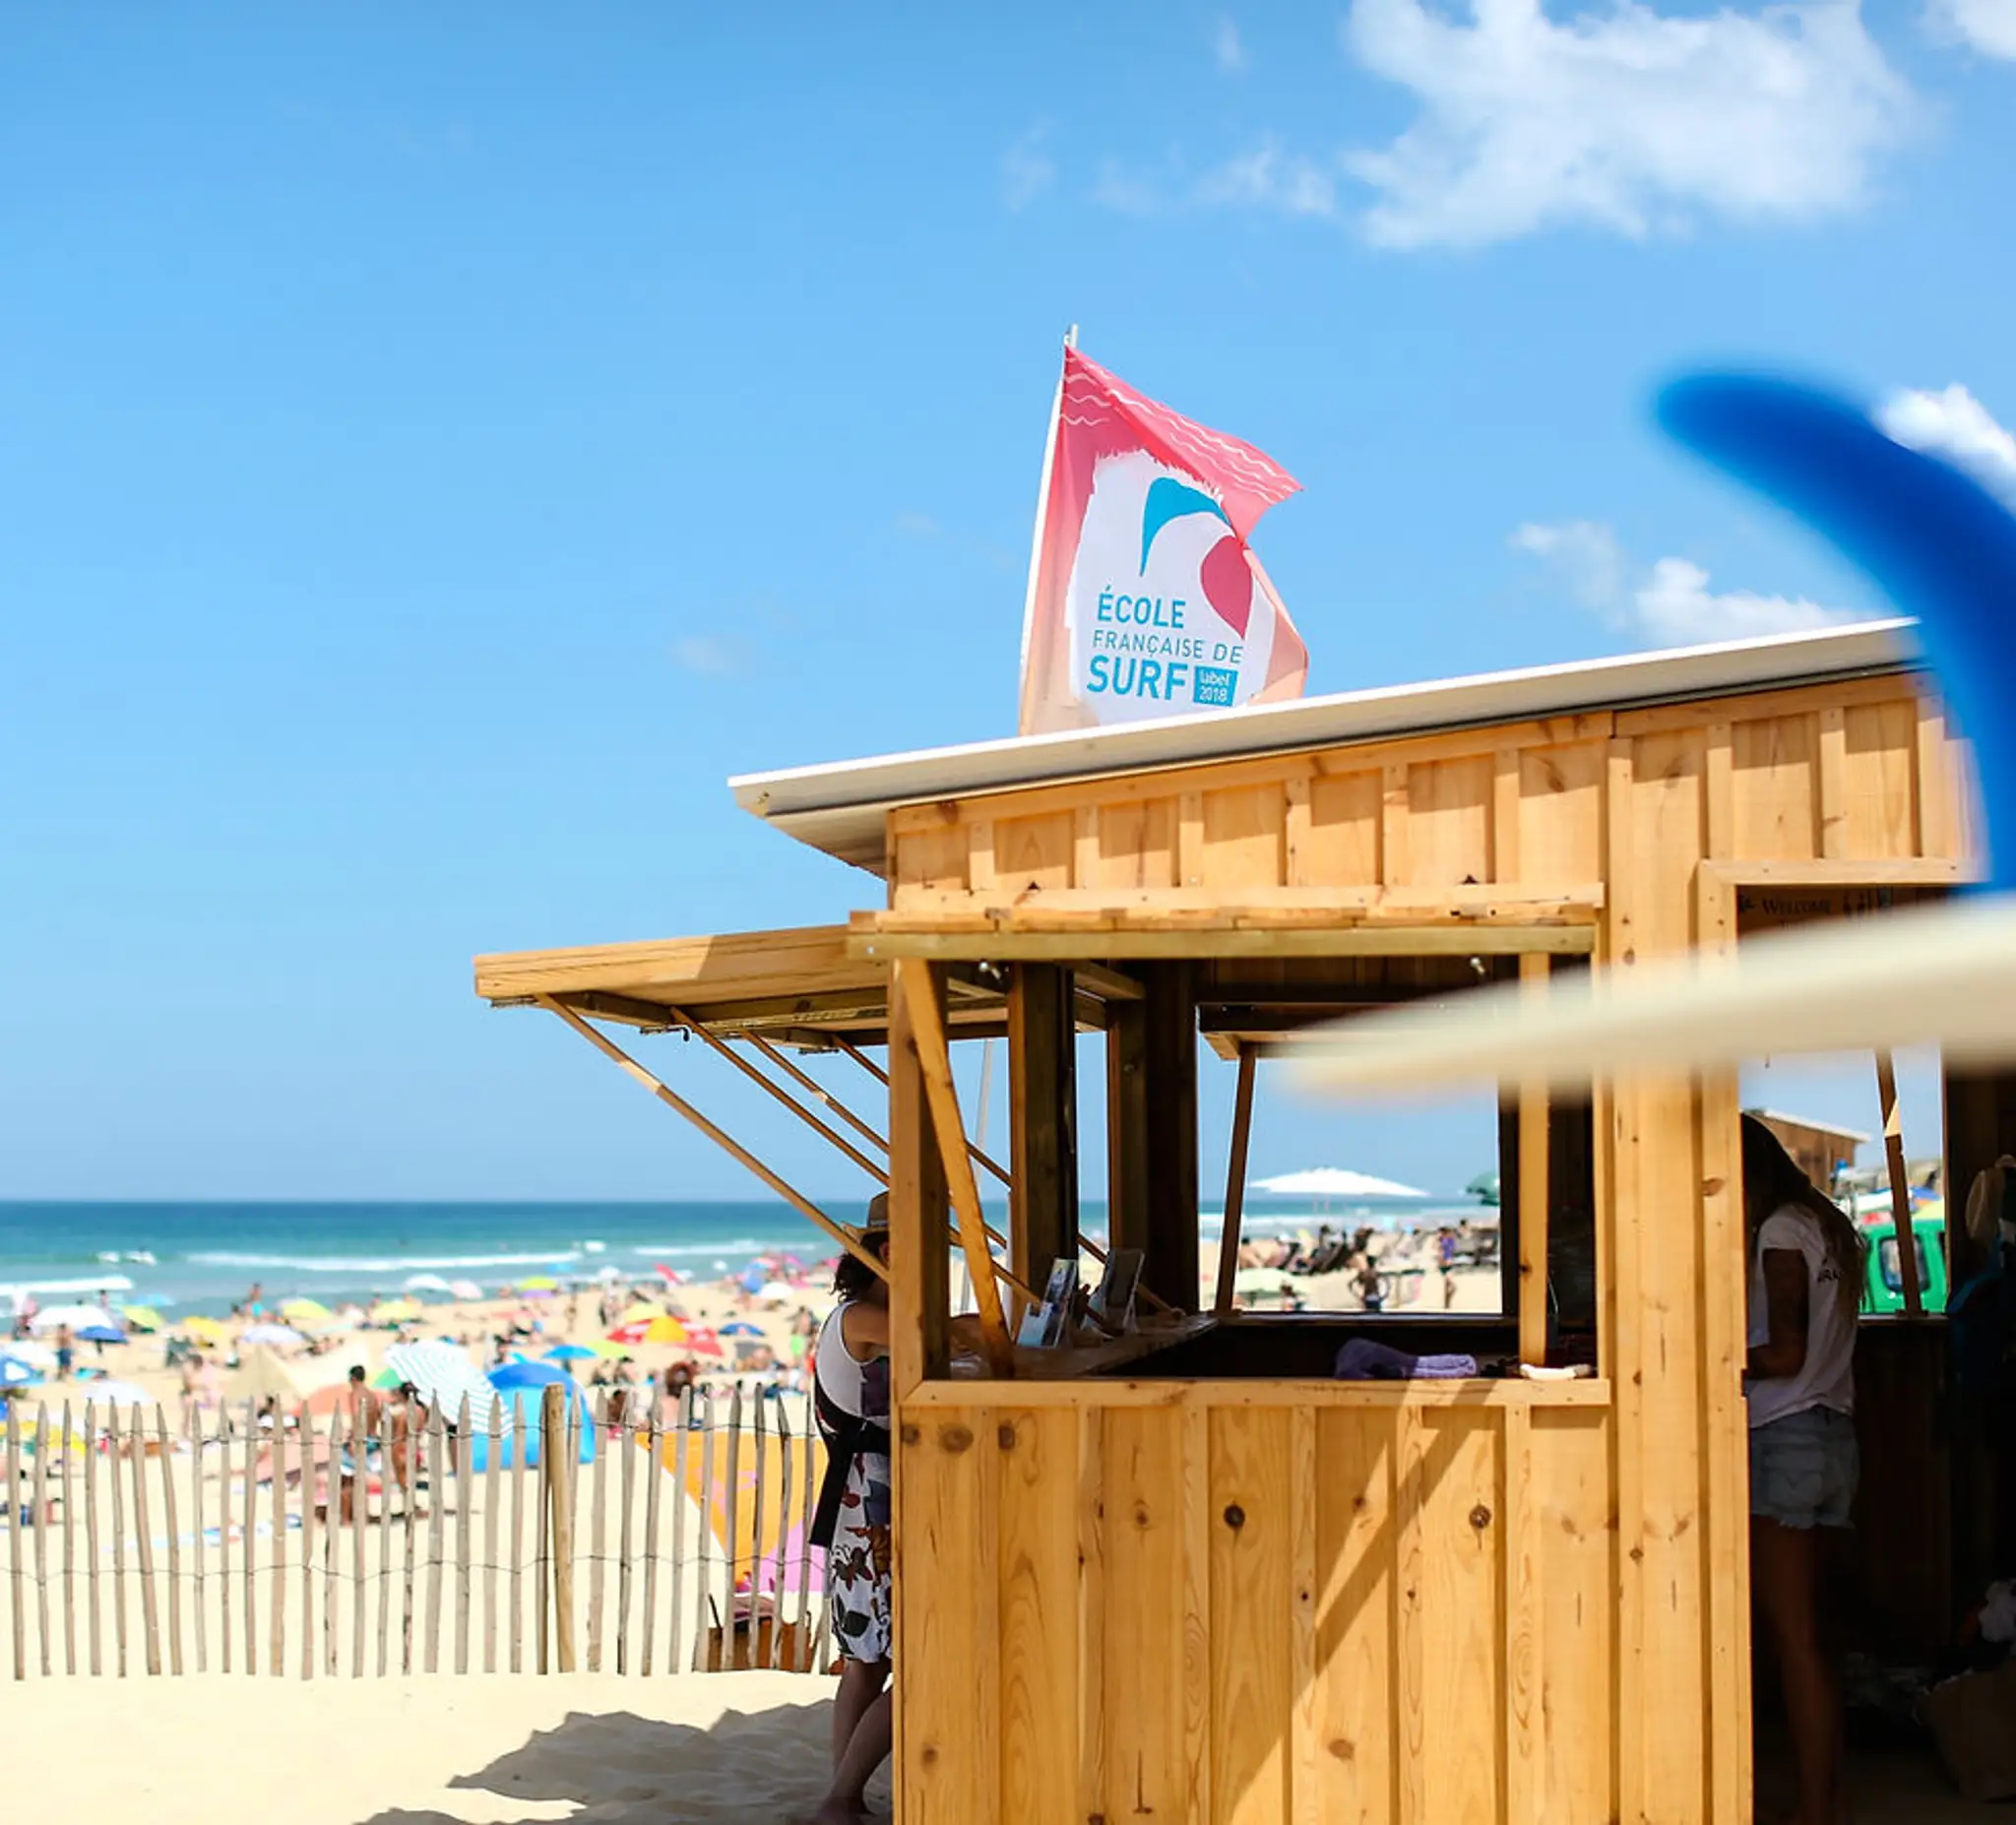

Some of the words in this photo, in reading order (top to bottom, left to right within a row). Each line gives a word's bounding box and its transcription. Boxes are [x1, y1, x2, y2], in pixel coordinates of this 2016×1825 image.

[1098, 585, 1186, 629] ÉCOLE
[1093, 630, 1204, 660] FRANÇAISE
[1213, 643, 1244, 664] DE
[1086, 655, 1189, 701] SURF
